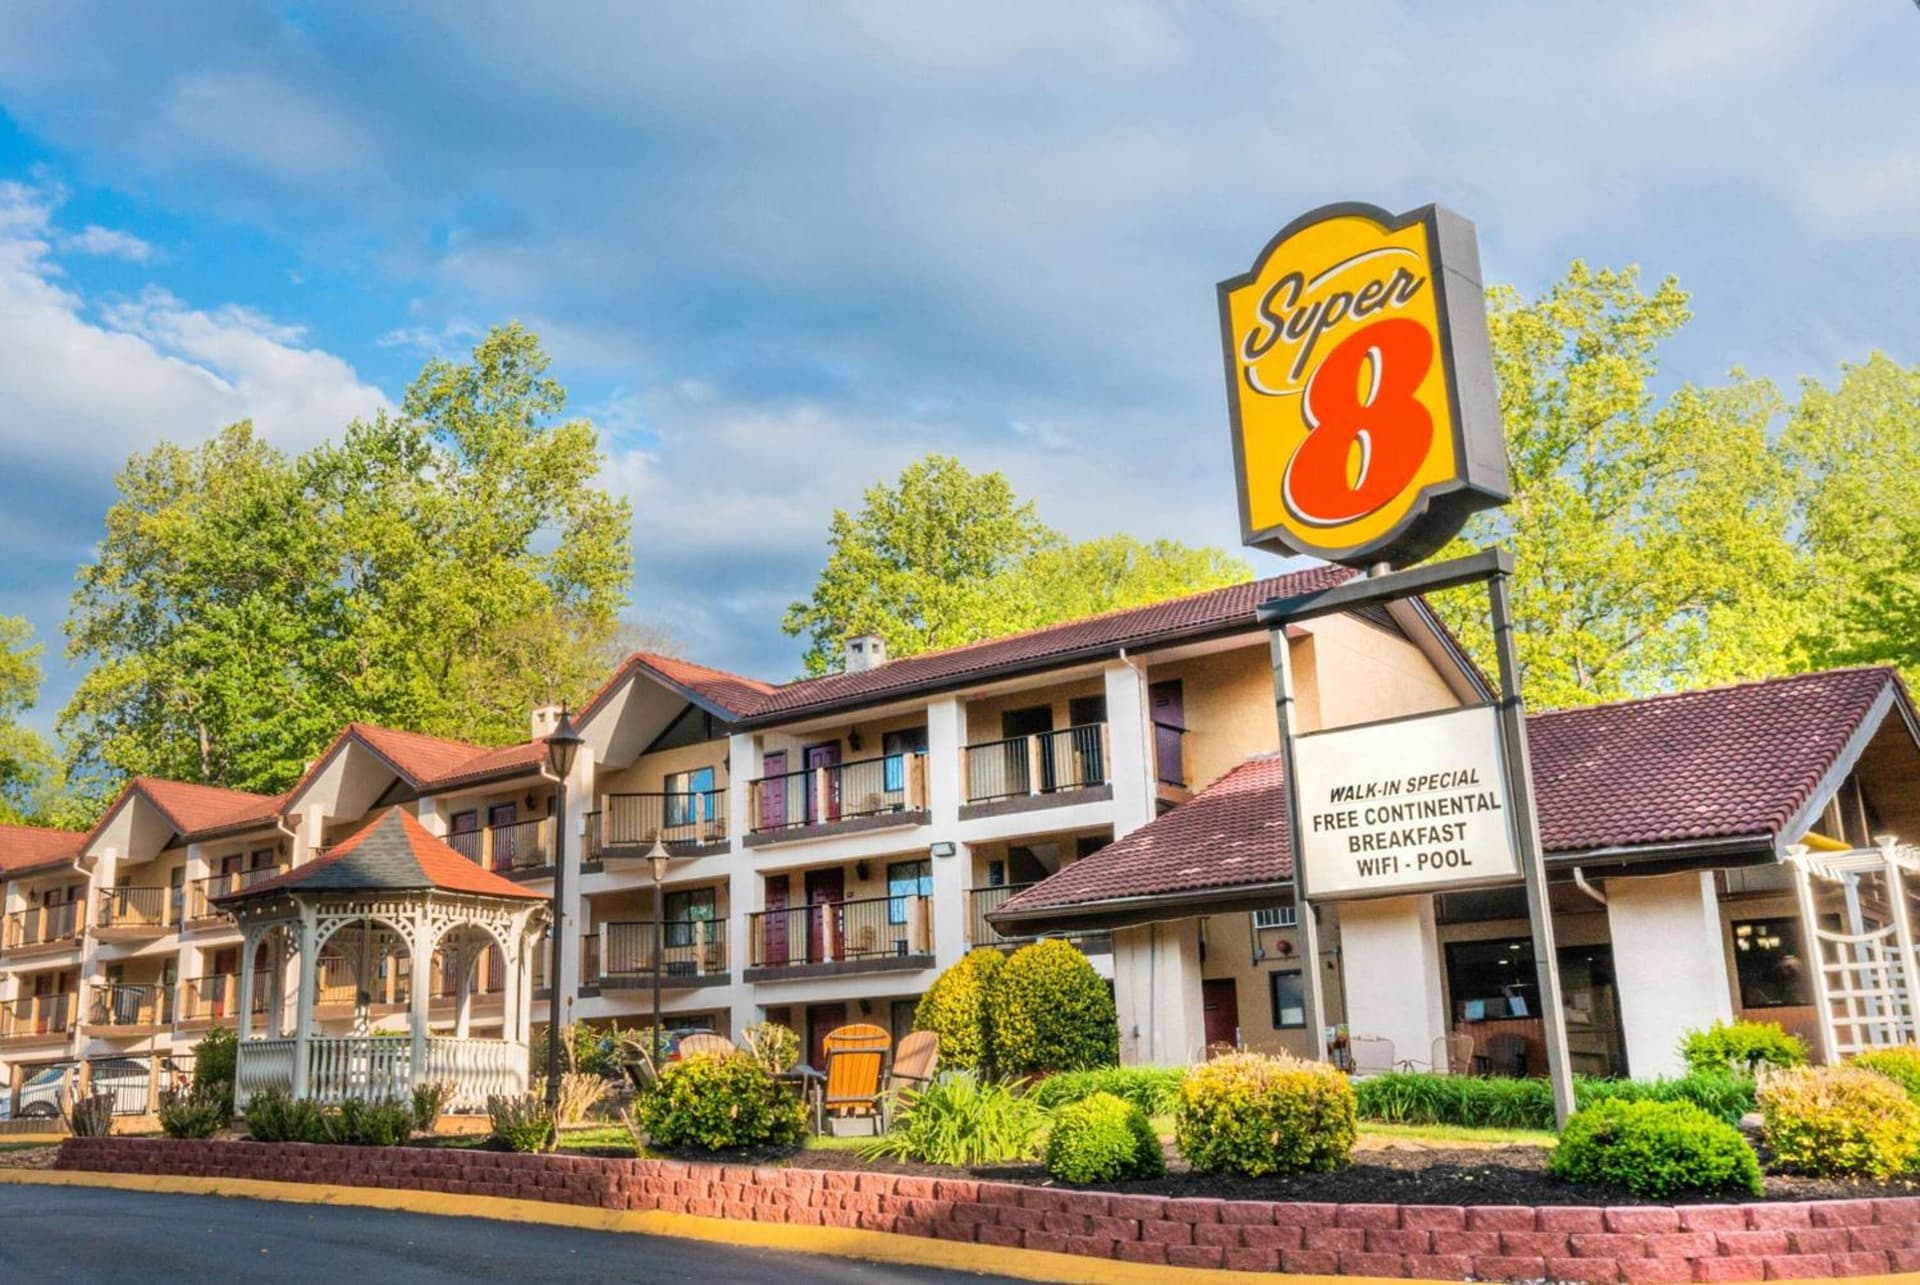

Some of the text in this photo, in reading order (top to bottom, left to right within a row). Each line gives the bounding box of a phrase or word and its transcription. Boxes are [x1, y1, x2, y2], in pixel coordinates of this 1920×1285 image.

[1241, 267, 1426, 384] Super
[1282, 317, 1434, 528] 8
[1330, 768, 1479, 803] WALK-IN SPECIAL
[1313, 791, 1501, 832] FREE CONTINENTAL
[1349, 822, 1467, 853] BREAKFAST
[1357, 856, 1399, 877] WIFI
[1417, 848, 1472, 871] POOL
